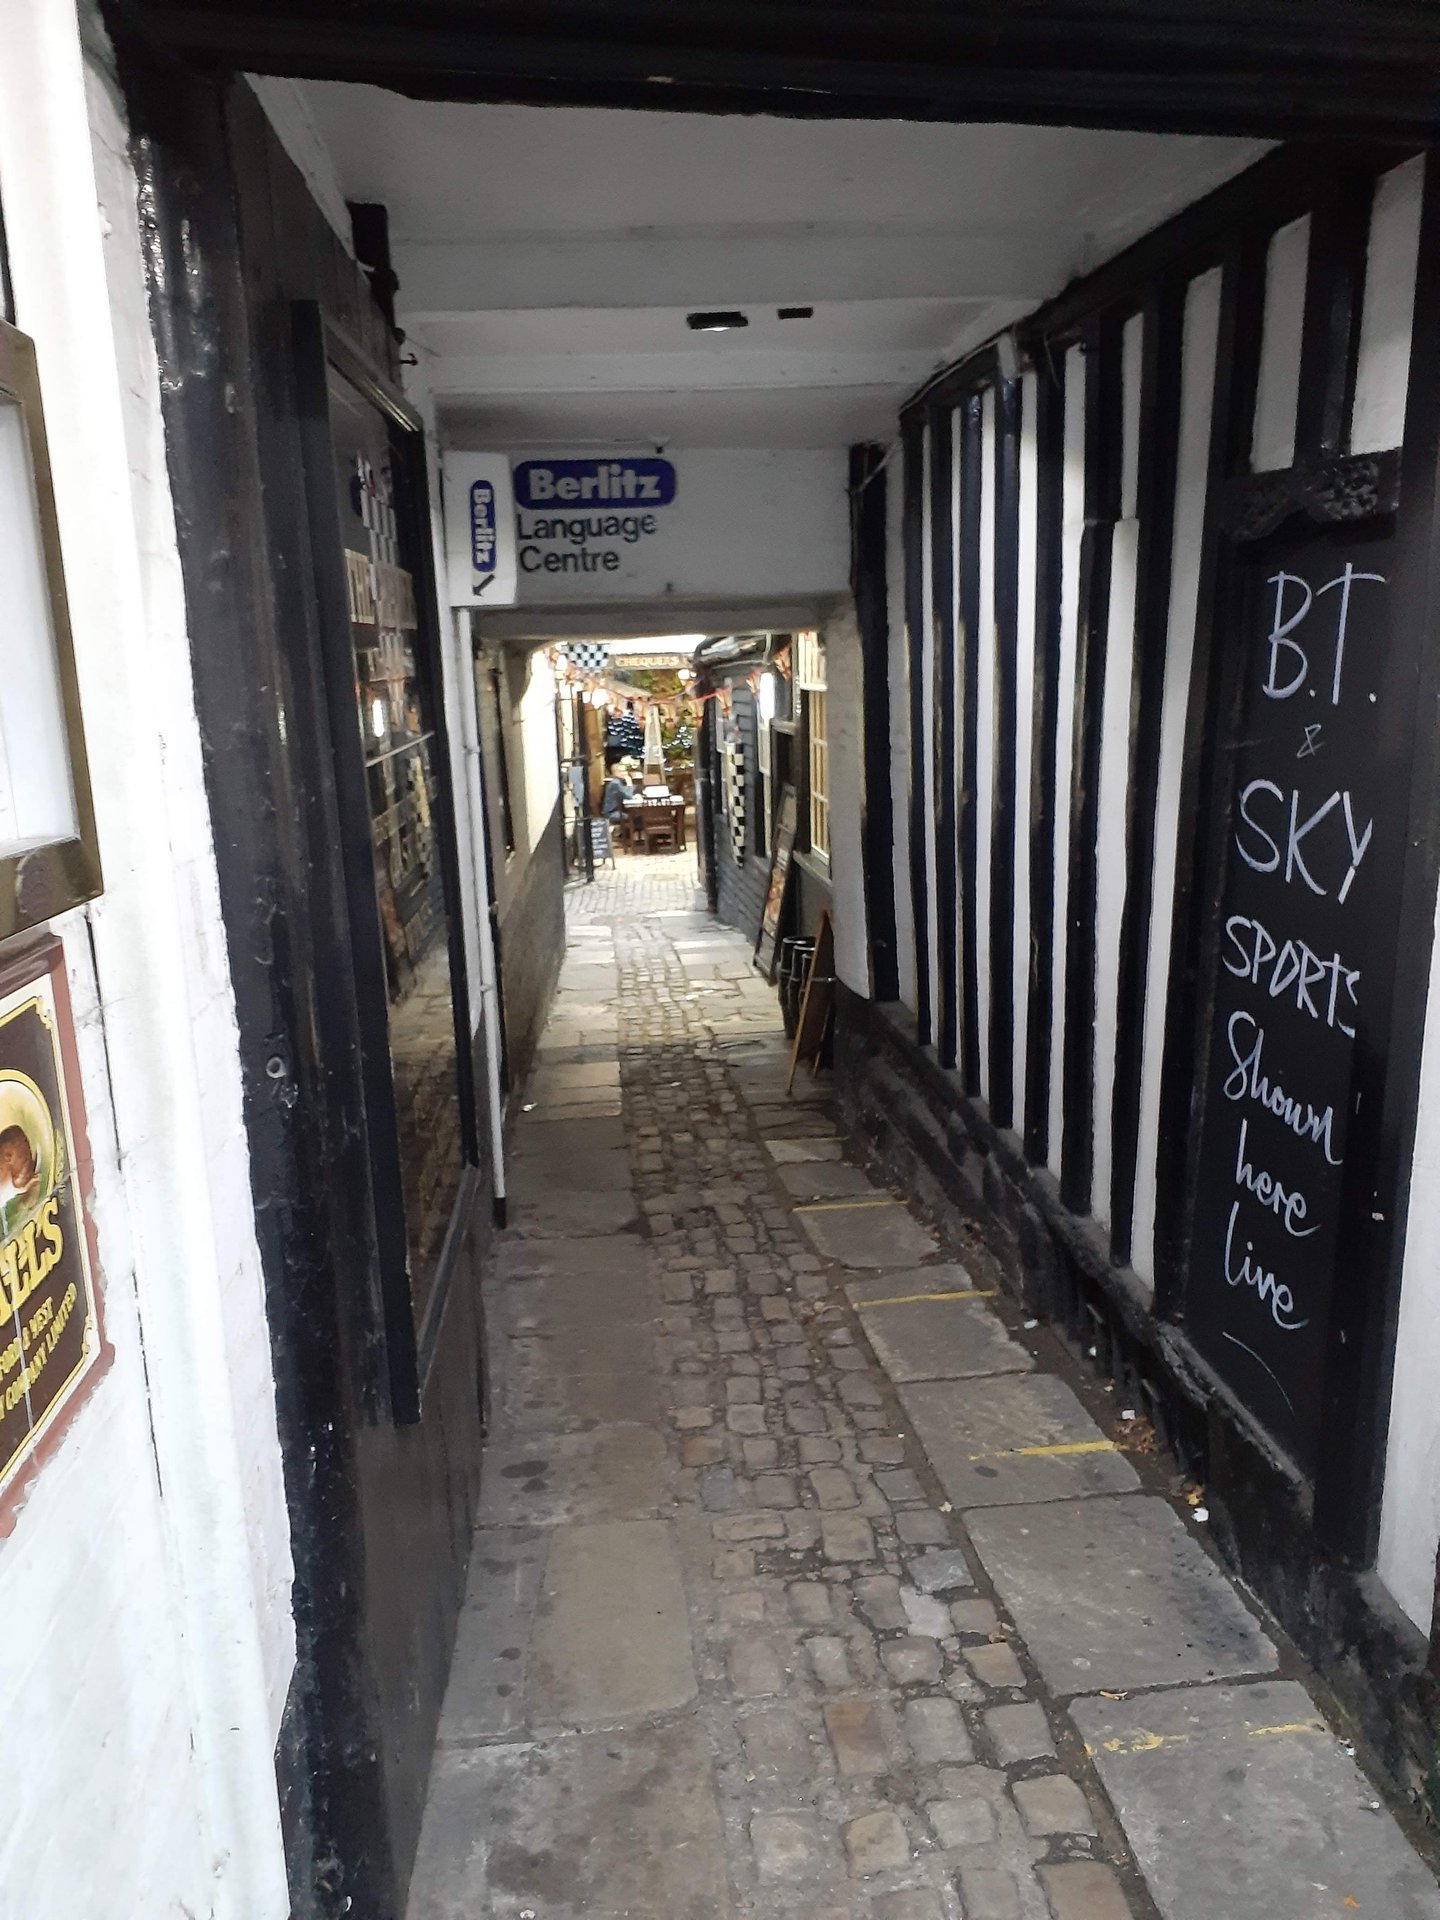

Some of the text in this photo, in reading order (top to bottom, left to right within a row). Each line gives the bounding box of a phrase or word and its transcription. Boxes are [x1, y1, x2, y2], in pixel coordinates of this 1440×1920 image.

[473, 488, 496, 564] Berlitz
[517, 513, 657, 545] Language
[530, 463, 661, 500] Berlitz
[519, 545, 620, 573] Centre
[1235, 779, 1373, 904] SKY
[1222, 915, 1360, 1039] SPORTS
[1223, 1010, 1343, 1165] Shown
[1235, 1118, 1322, 1237] here
[1225, 1200, 1310, 1330] live
